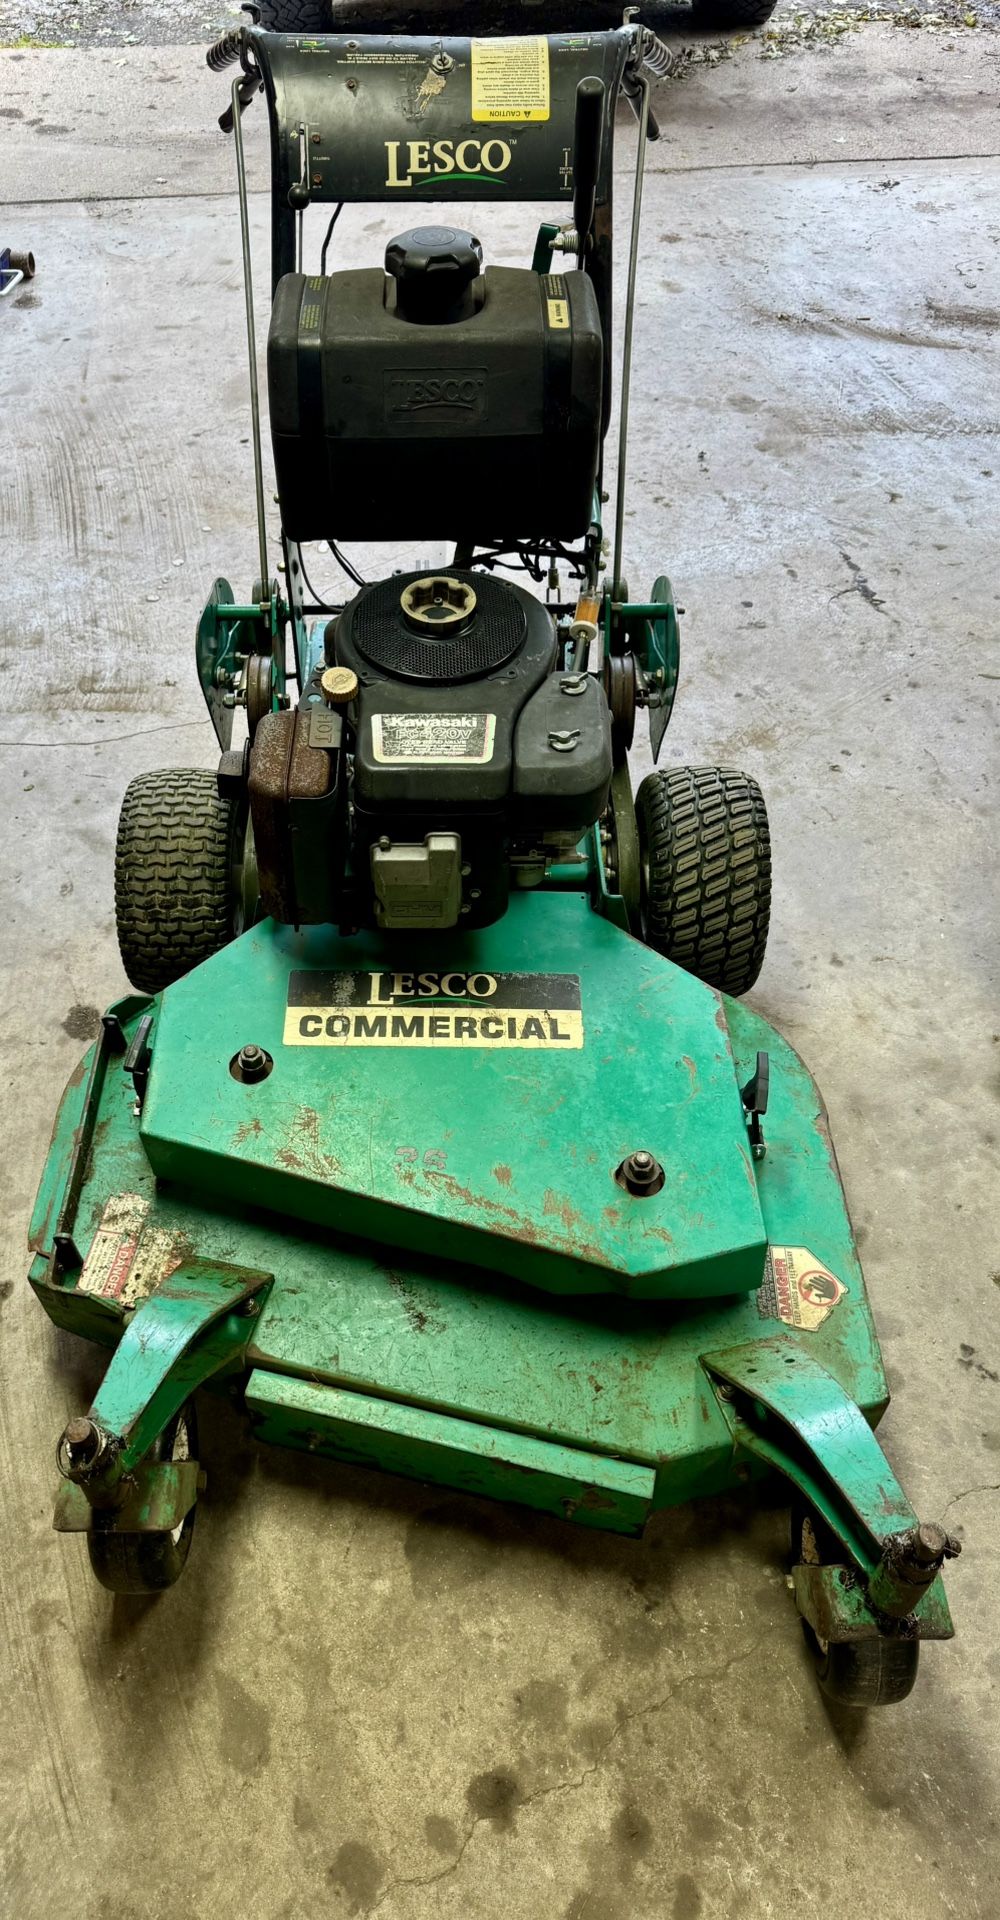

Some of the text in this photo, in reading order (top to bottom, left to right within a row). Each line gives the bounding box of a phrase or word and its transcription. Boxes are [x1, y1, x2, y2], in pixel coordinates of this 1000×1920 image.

[384, 139, 512, 187] LESCO
[315, 714, 333, 744] HOT
[388, 716, 478, 728] Kawasaki
[395, 727, 472, 740] FC420V
[366, 972, 498, 1006] LESCO
[298, 1014, 571, 1041] COMMERCIAL
[104, 1250, 129, 1296] DANGER
[774, 1258, 792, 1316] DANGER
[791, 1291, 800, 1310] HANDS
[794, 1310, 802, 1325] KEEP
